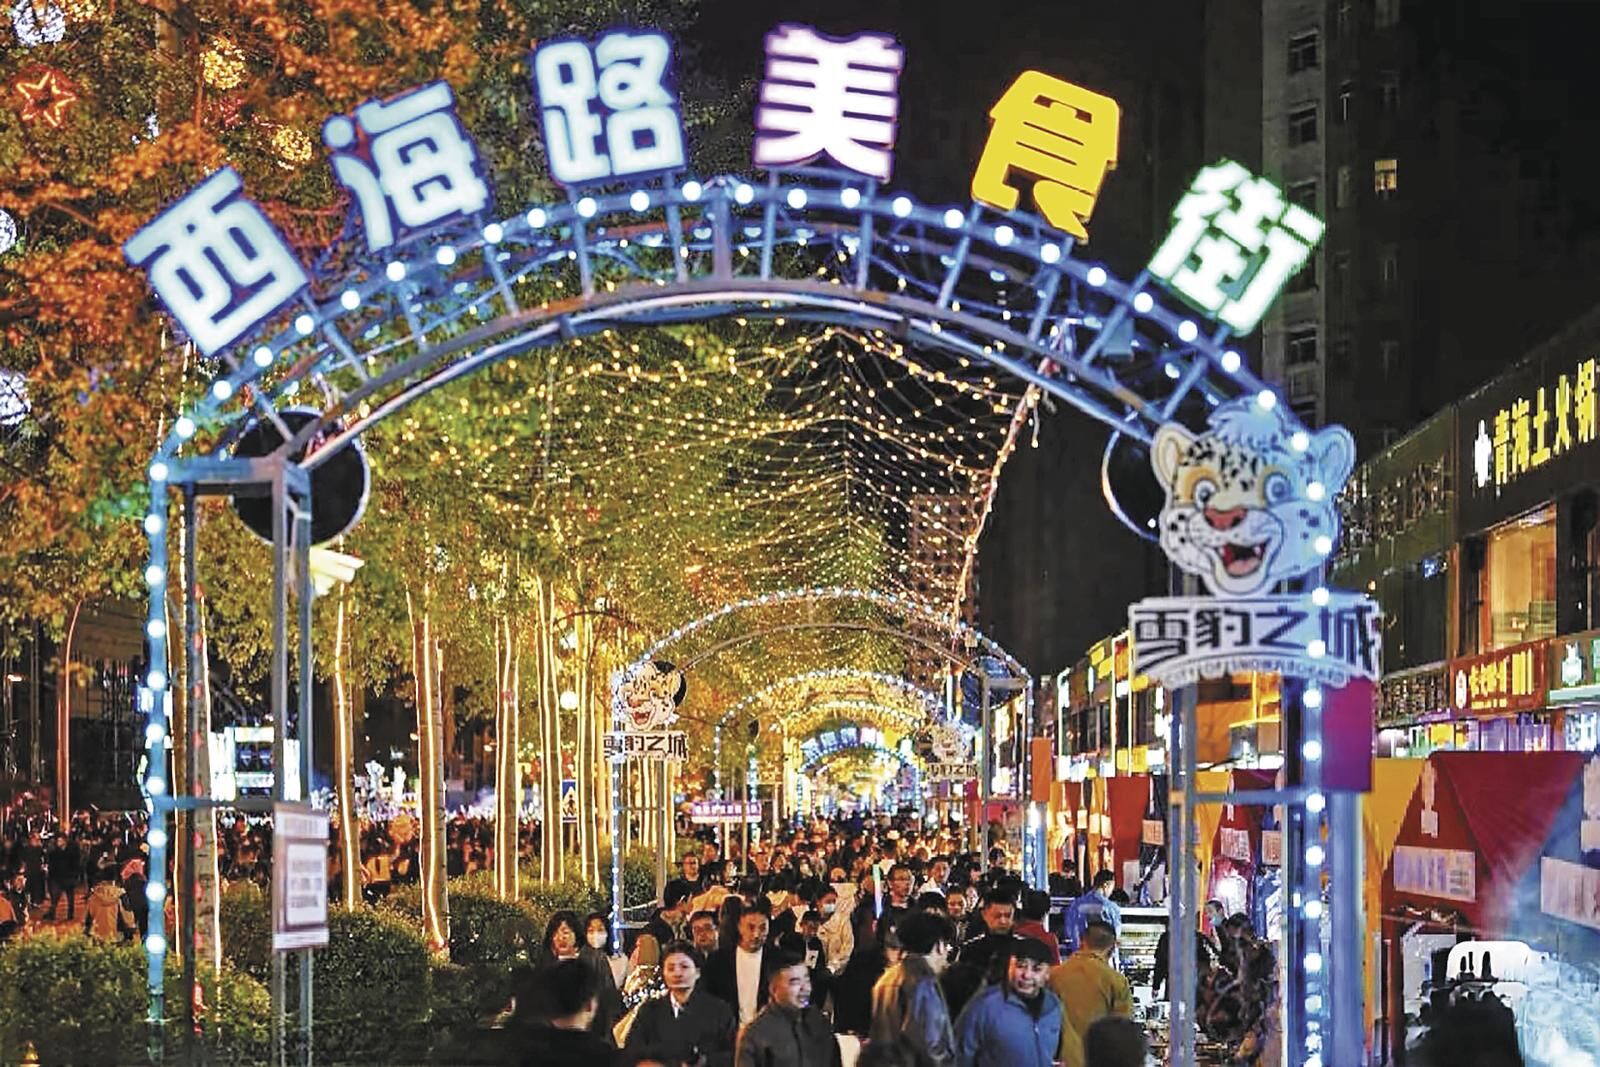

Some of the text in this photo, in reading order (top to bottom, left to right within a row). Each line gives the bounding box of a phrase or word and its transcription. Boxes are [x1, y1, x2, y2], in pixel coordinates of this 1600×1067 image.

[123, 24, 1326, 356] 西海路美食街
[1493, 357, 1596, 486] 青海土火锅
[1133, 603, 1375, 673] 雪豹之城
[603, 733, 688, 760] 雪豹之城
